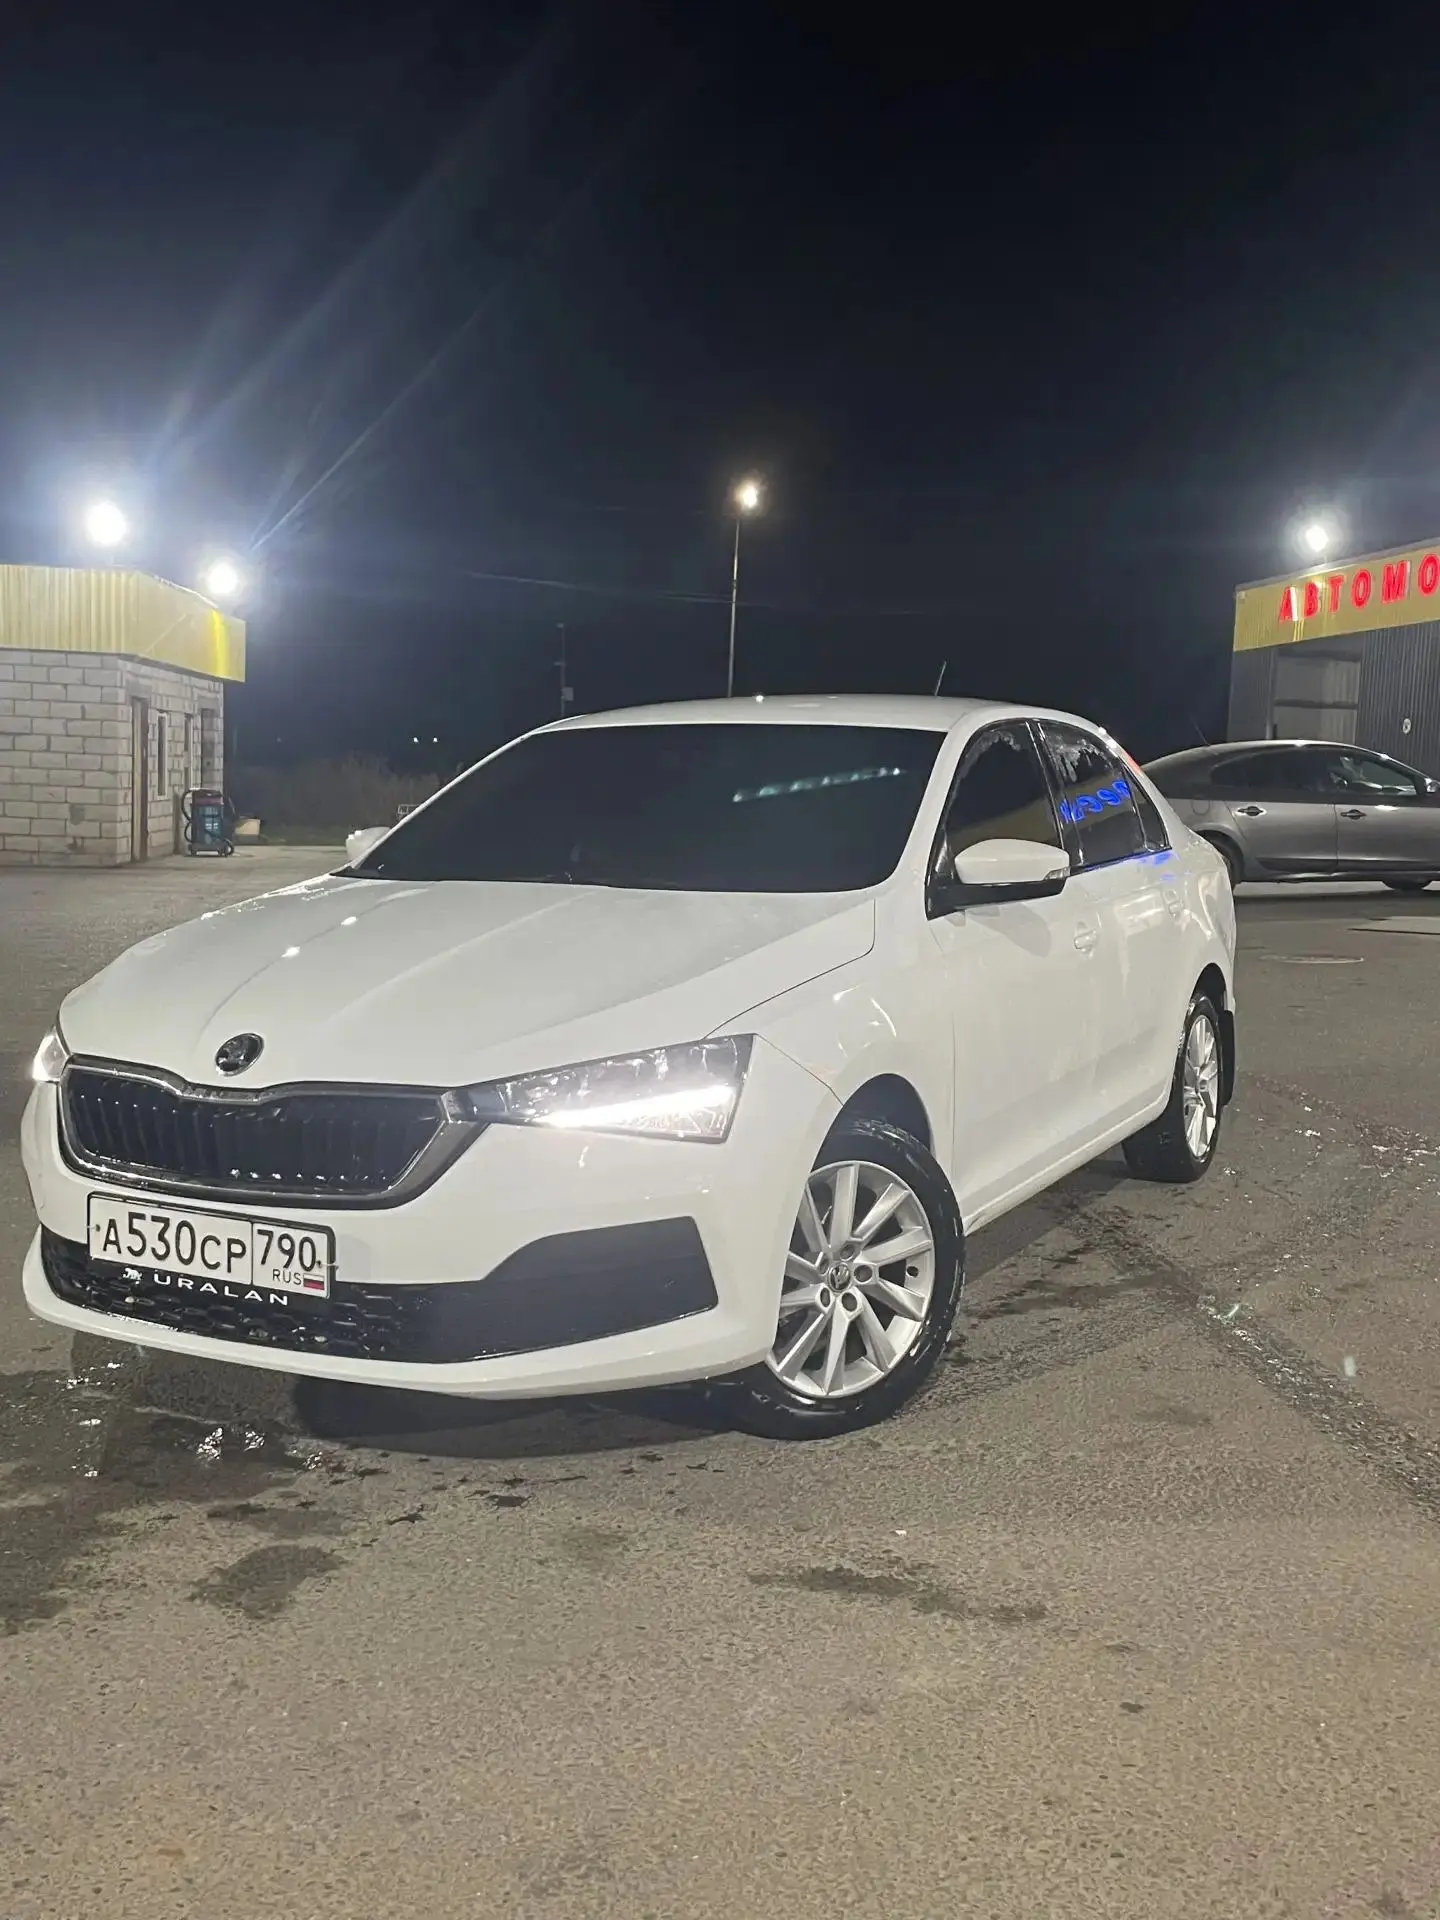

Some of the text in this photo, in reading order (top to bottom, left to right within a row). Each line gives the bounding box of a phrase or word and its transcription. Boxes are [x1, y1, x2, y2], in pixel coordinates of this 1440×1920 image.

[256, 1228, 317, 1272] 790
[153, 1272, 289, 1306] URALAN
[272, 1268, 302, 1285] RUS
